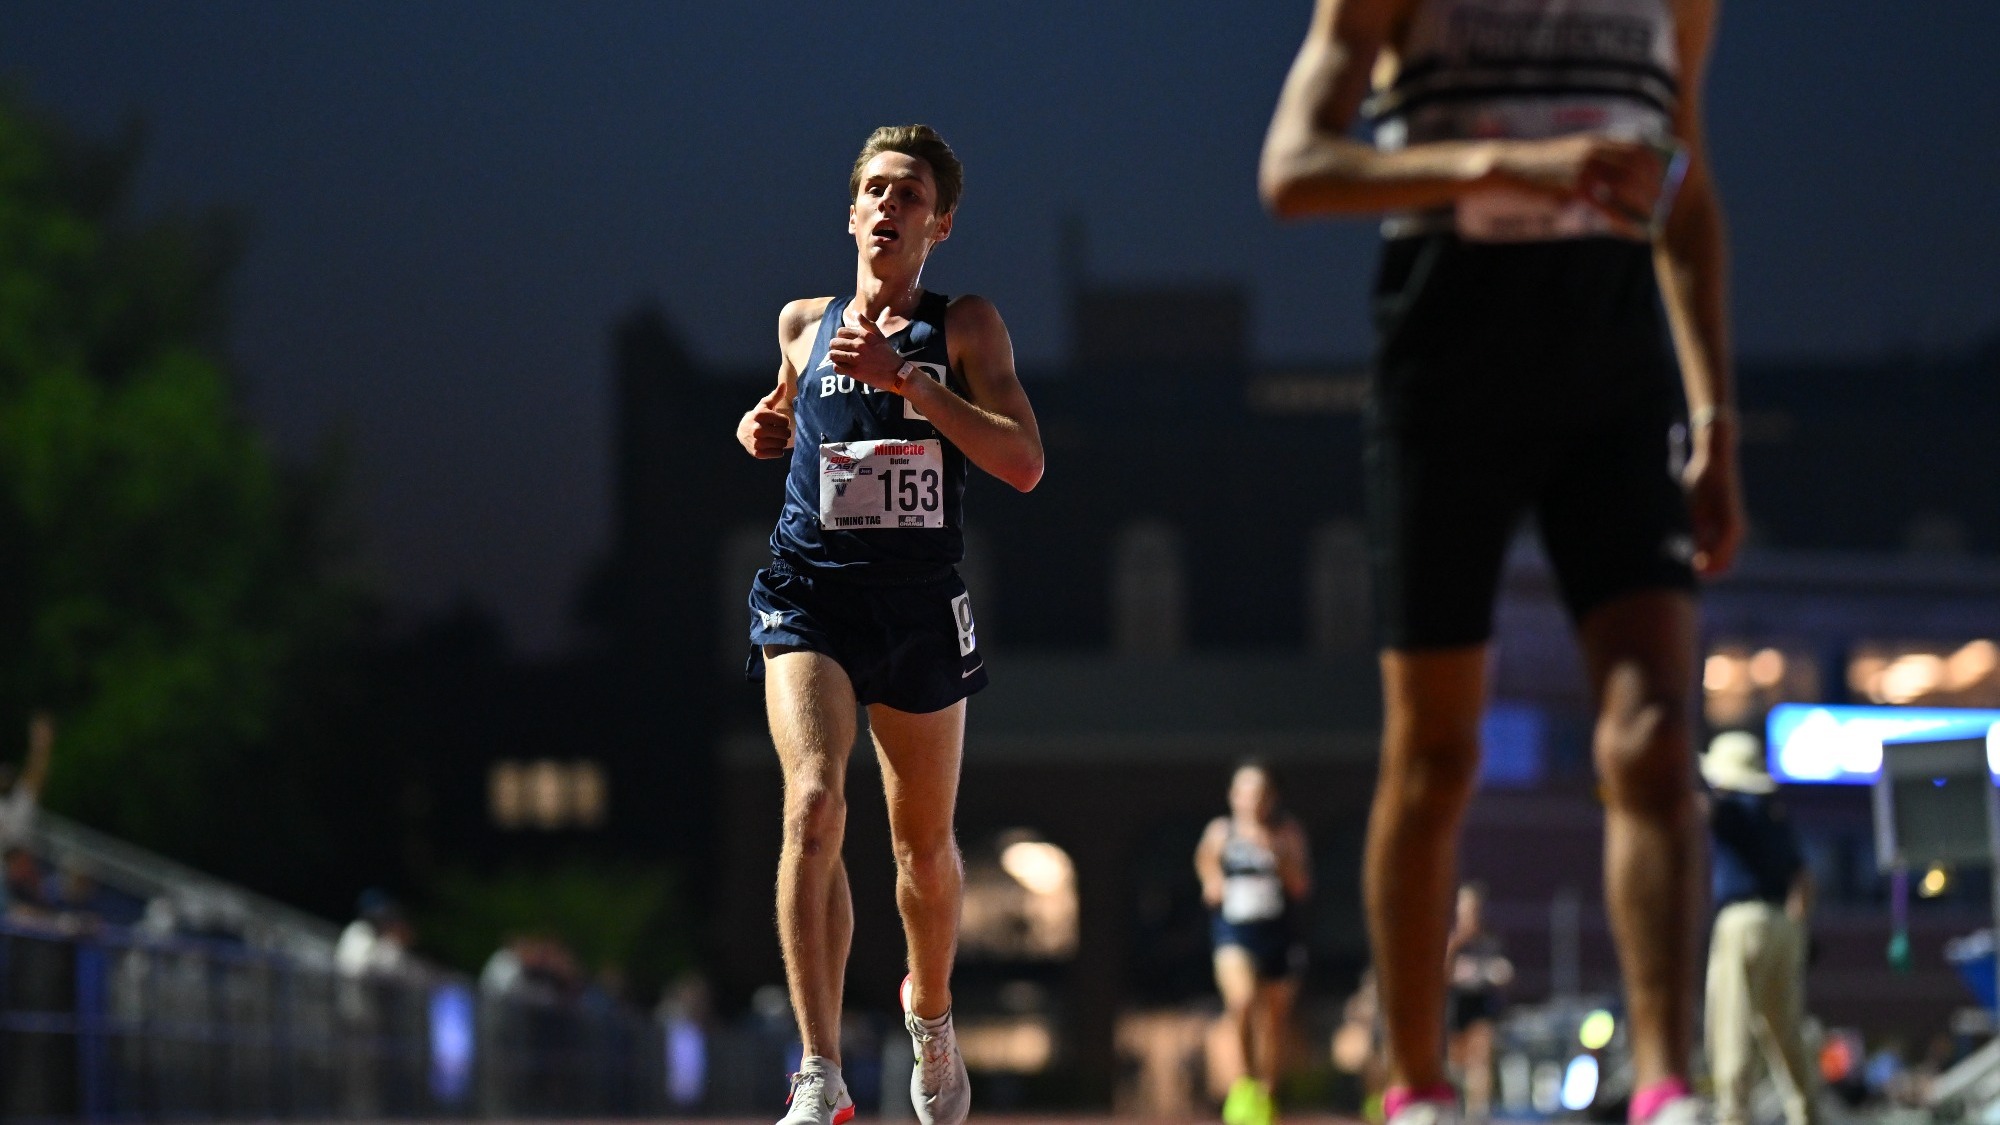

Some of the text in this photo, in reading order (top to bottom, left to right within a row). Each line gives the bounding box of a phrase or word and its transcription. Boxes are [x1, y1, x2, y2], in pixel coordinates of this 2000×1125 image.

[874, 444, 925, 456] Minnette
[830, 456, 851, 464] BIG
[878, 469, 939, 512] 153
[835, 516, 881, 526] TIMING TAG
